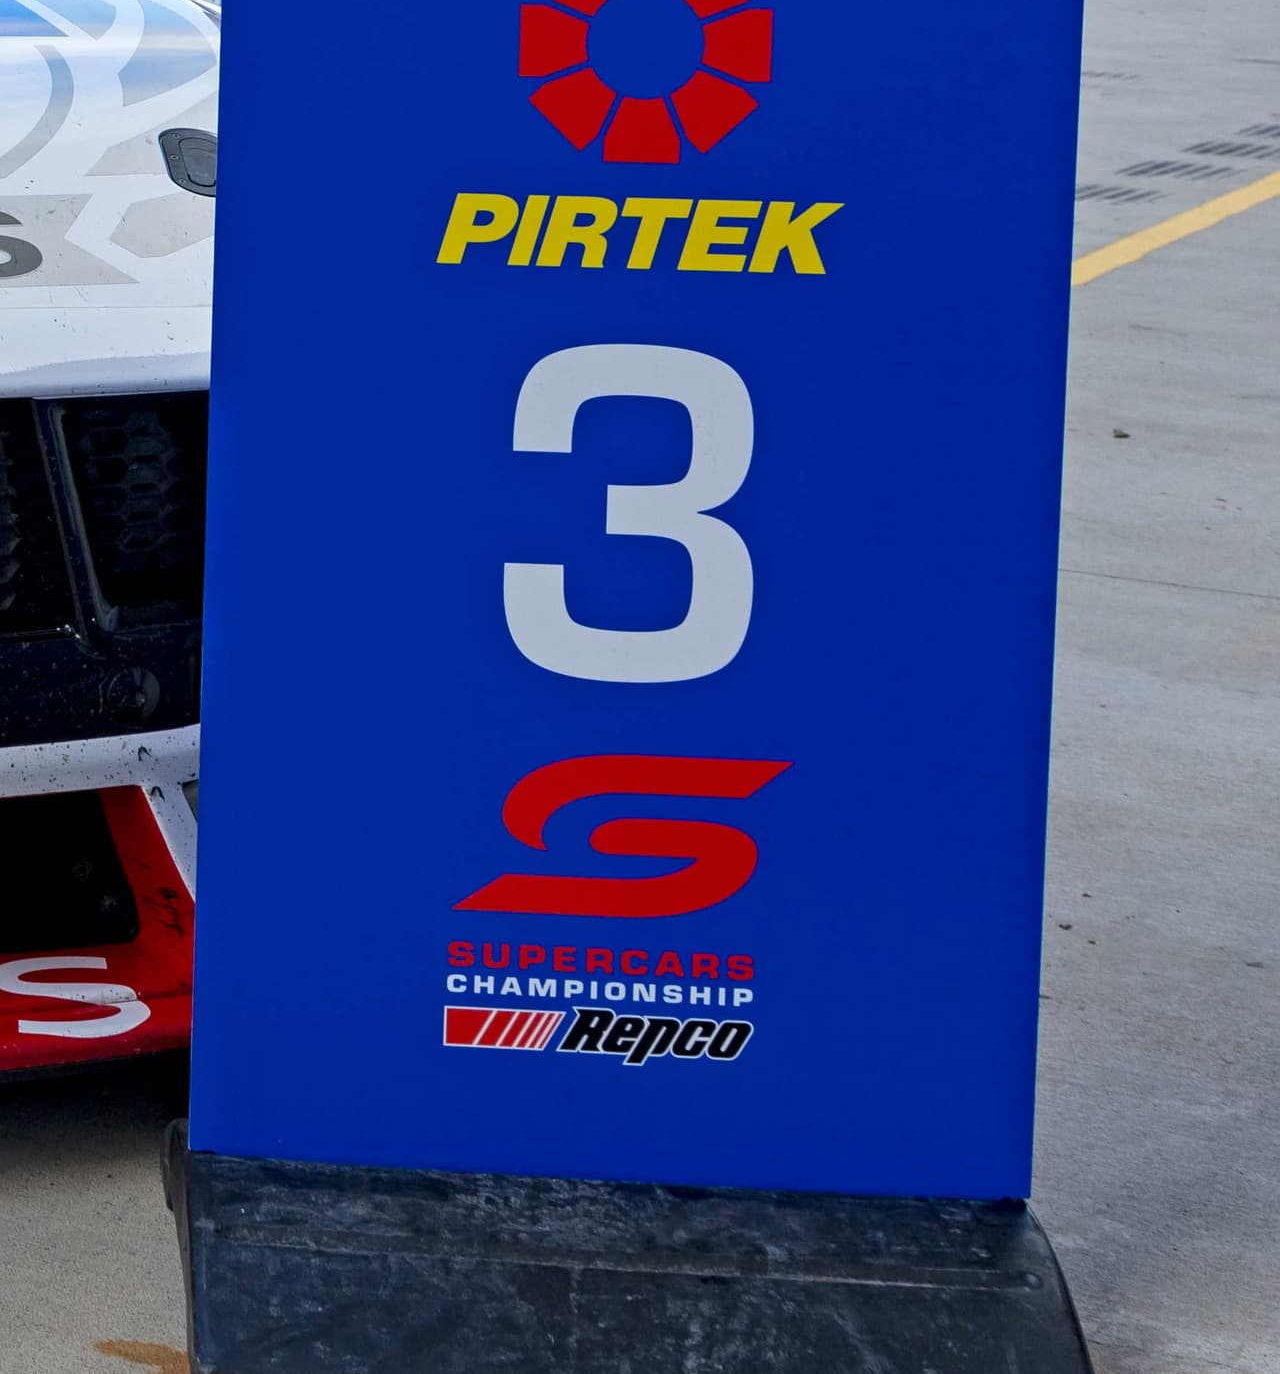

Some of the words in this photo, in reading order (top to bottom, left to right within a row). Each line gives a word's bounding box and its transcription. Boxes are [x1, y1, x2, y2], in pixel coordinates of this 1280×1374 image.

[436, 191, 847, 275] PIRTEK
[501, 342, 755, 684] 3
[445, 972, 756, 1008] CHAMPIONSHIP
[446, 940, 757, 984] SUPERCARS
[559, 1005, 756, 1067] Repco
